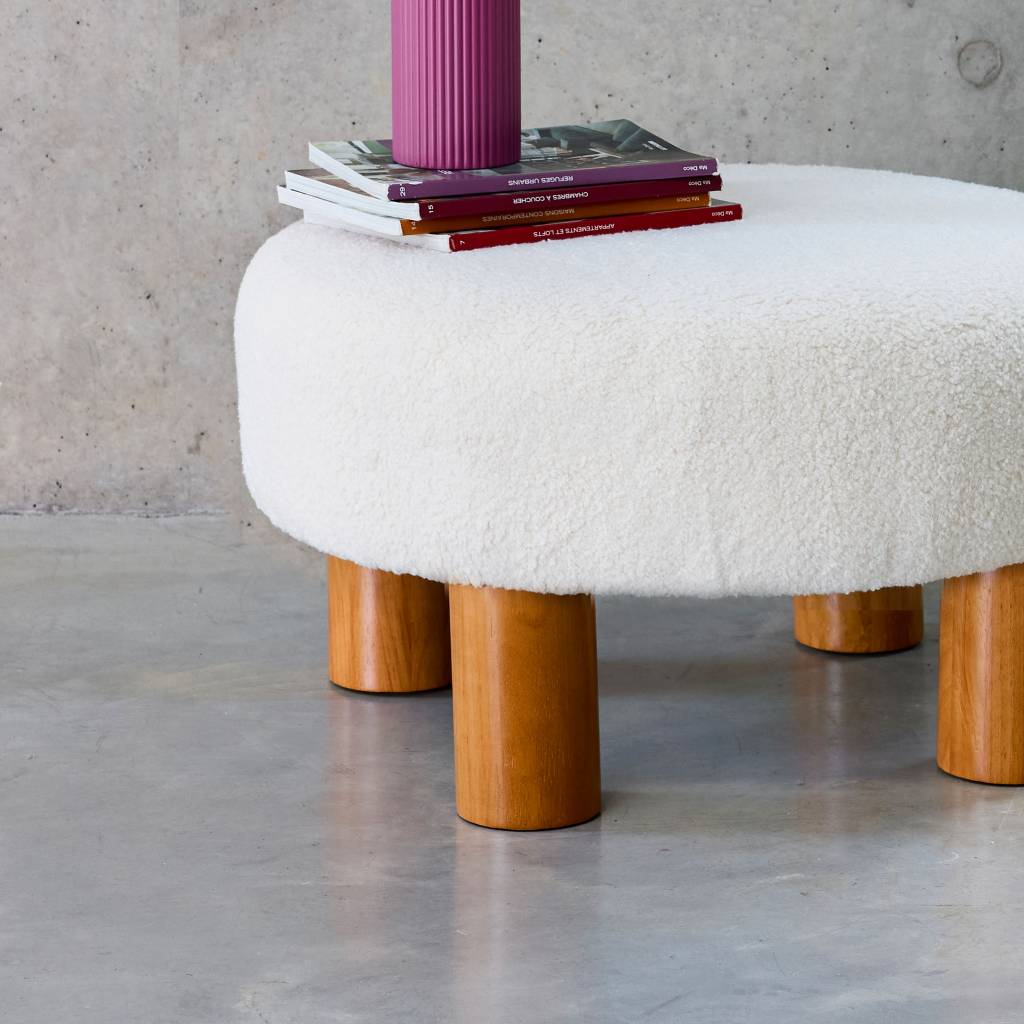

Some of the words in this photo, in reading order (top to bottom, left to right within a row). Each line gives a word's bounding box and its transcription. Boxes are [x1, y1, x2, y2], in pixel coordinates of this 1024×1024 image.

[507, 178, 540, 187] URBAINS
[541, 175, 574, 184] REFUGES
[513, 195, 545, 204] COUCHER
[552, 191, 589, 201] CHAMBRES
[428, 204, 434, 213] 15
[544, 208, 575, 216] MAISONS
[482, 211, 544, 222] CONTEMPORAINES
[565, 223, 615, 234] APPARTEMENTS
[533, 230, 555, 238] LOFTS
